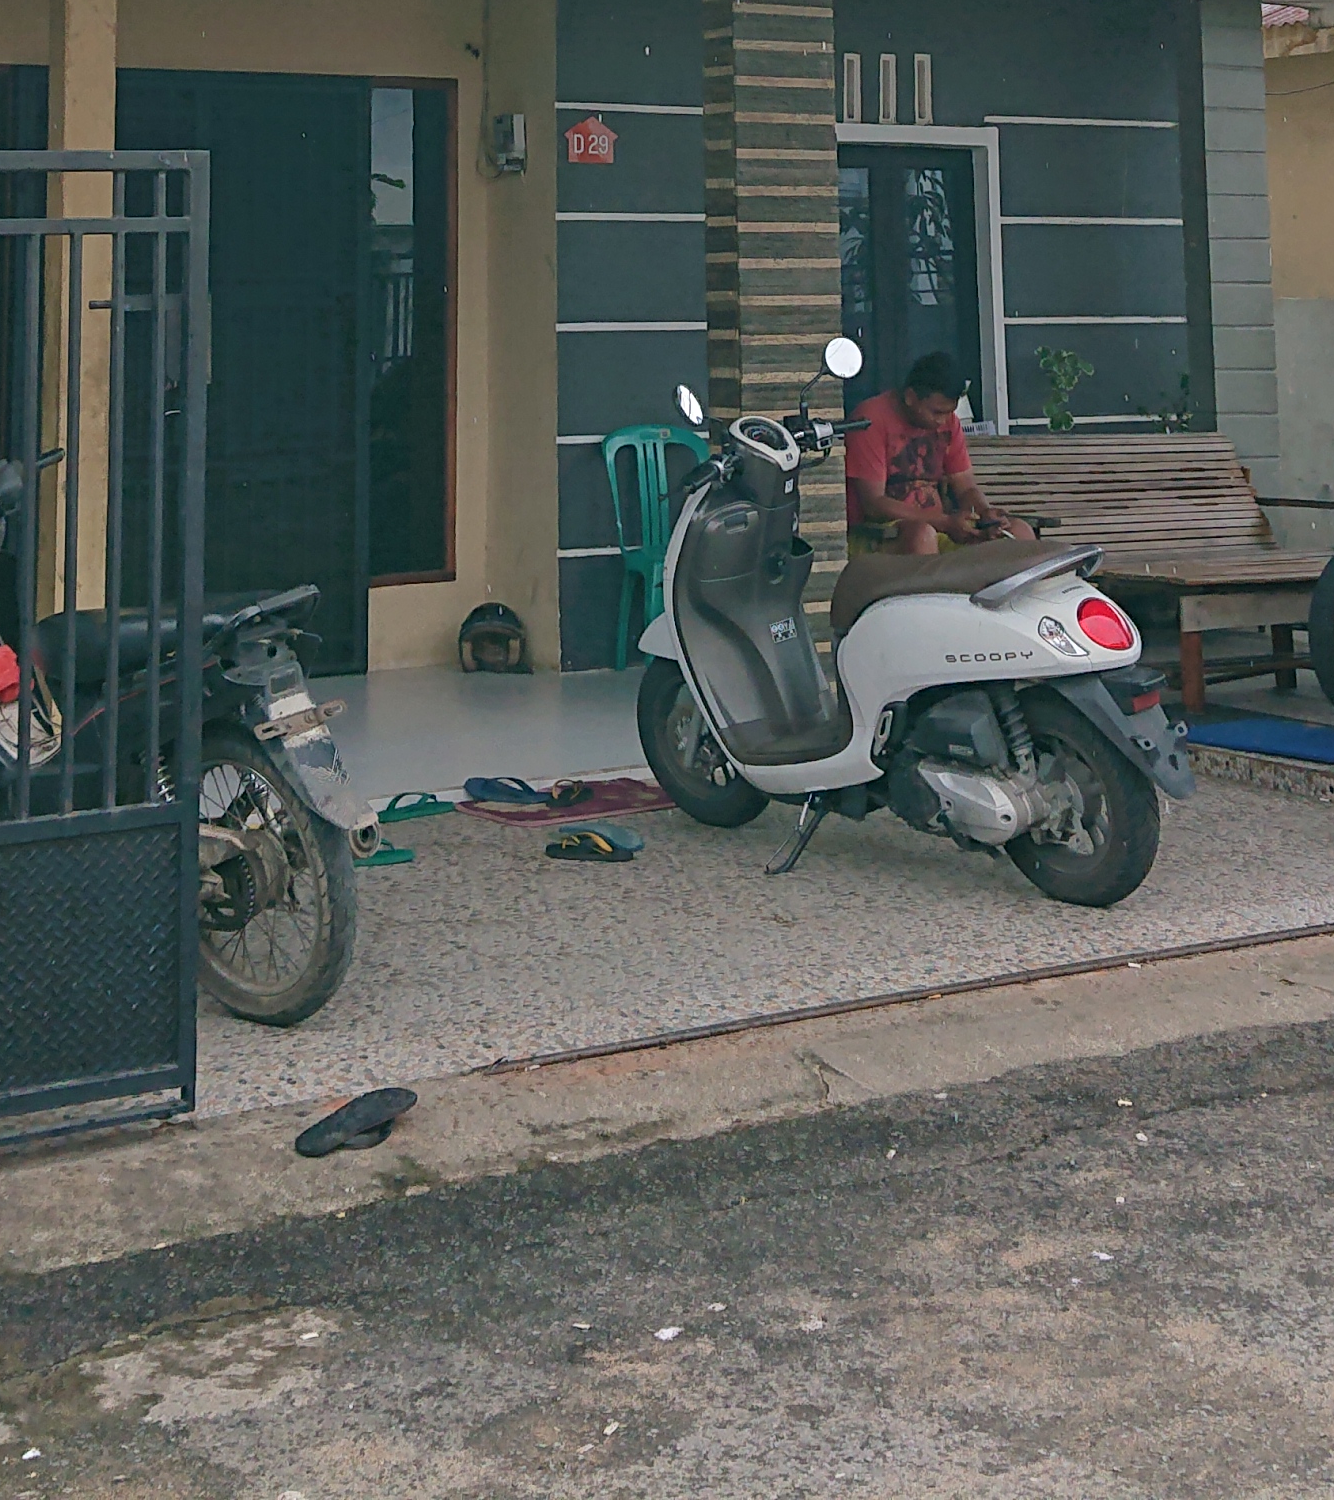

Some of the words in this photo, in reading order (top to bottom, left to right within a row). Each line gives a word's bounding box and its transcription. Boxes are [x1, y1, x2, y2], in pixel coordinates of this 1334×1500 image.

[573, 133, 585, 154] D
[588, 134, 609, 155] 29
[945, 650, 1034, 664] SCOOPY
